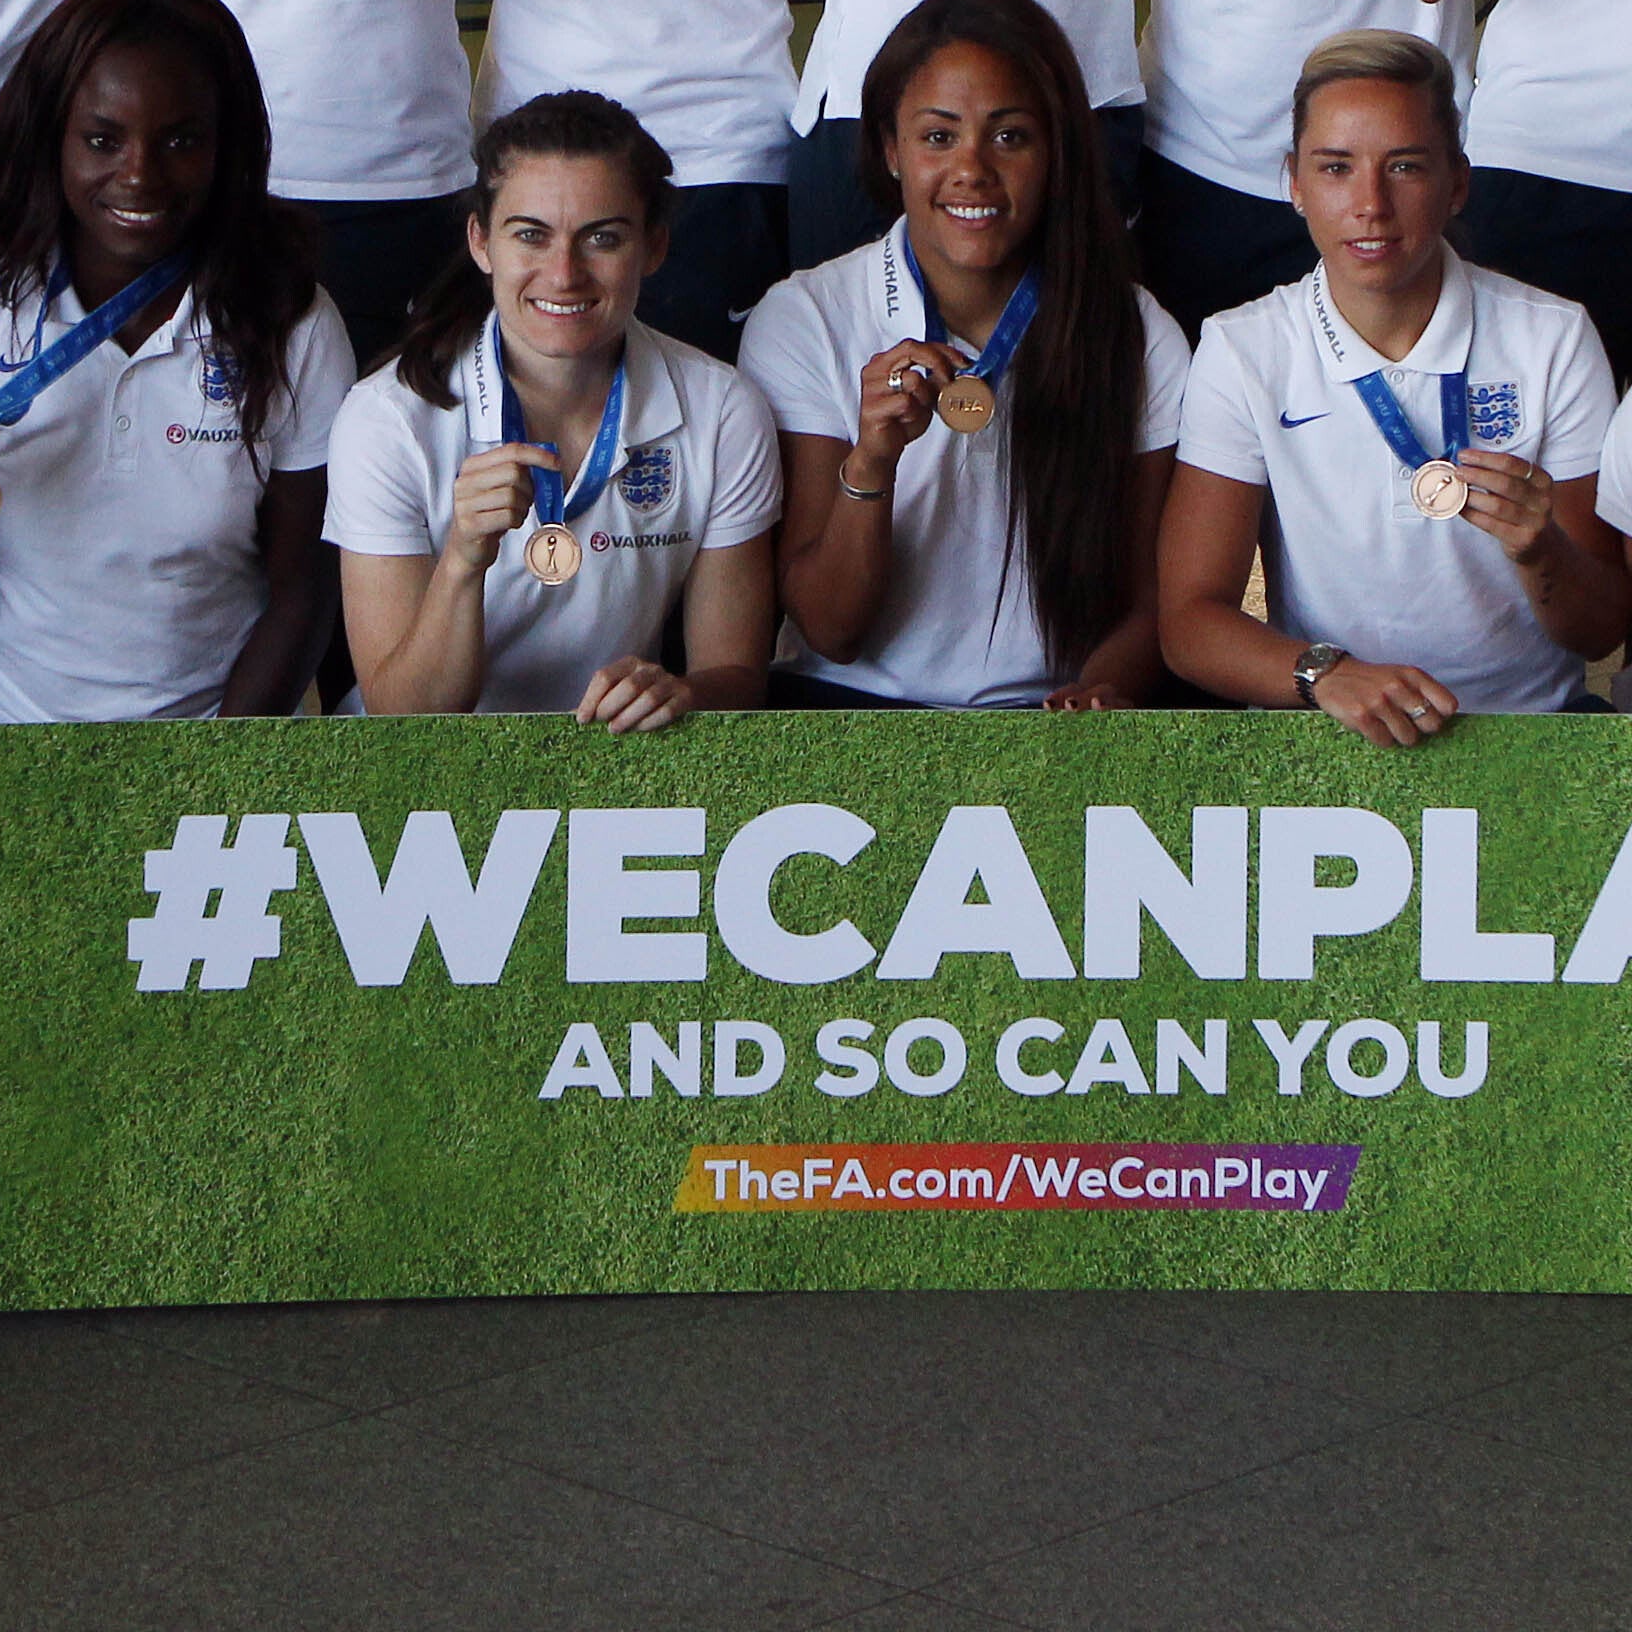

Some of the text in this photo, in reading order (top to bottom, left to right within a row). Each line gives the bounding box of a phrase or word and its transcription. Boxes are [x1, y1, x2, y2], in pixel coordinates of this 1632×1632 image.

[881, 235, 900, 318] AUXHALL
[1312, 266, 1346, 363] VAUXHALL
[610, 531, 694, 551] VAUXHALL
[538, 1017, 1489, 1100] AND SO CAN YOU
[703, 1153, 1329, 1211] TheFA.com/WeCanPlay
